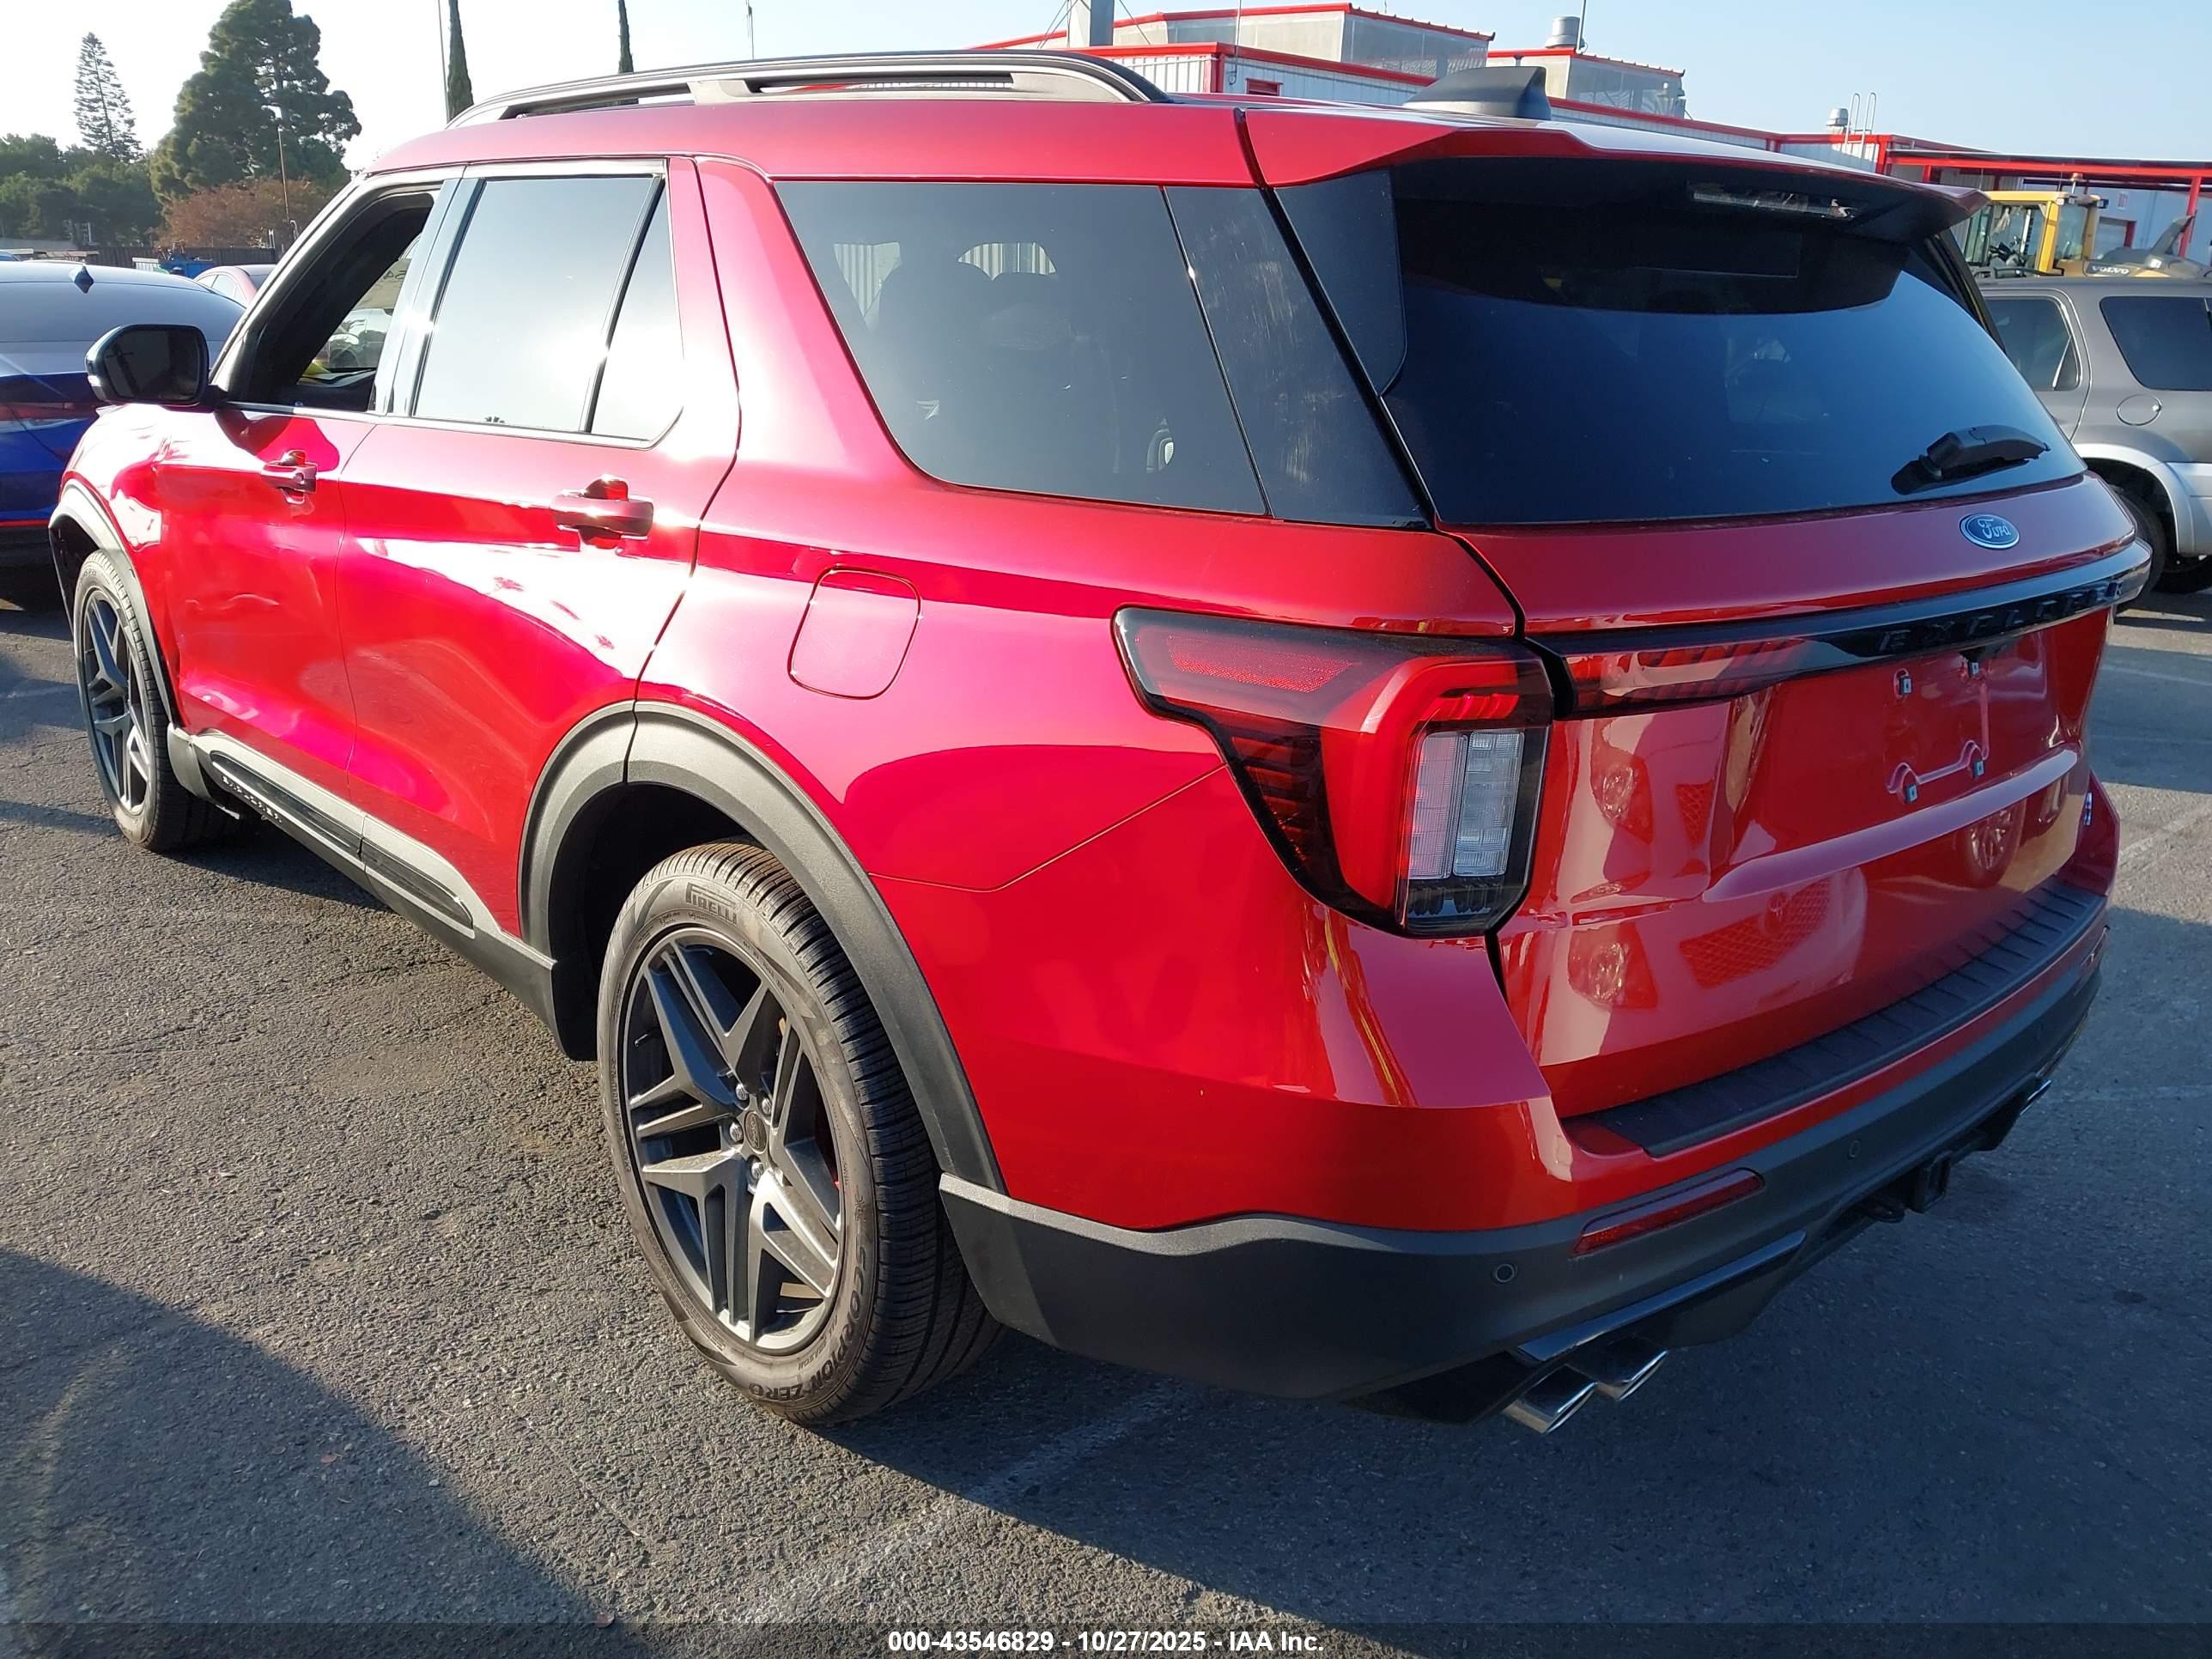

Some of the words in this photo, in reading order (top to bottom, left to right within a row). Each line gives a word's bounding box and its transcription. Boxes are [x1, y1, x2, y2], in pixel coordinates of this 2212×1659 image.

[2092, 265, 2130, 275] VOLVO
[1977, 518, 2012, 539] Ford
[685, 882, 738, 925] PIRELLI
[809, 1242, 867, 1392] SCORPION
[748, 1382, 805, 1401] ZERO
